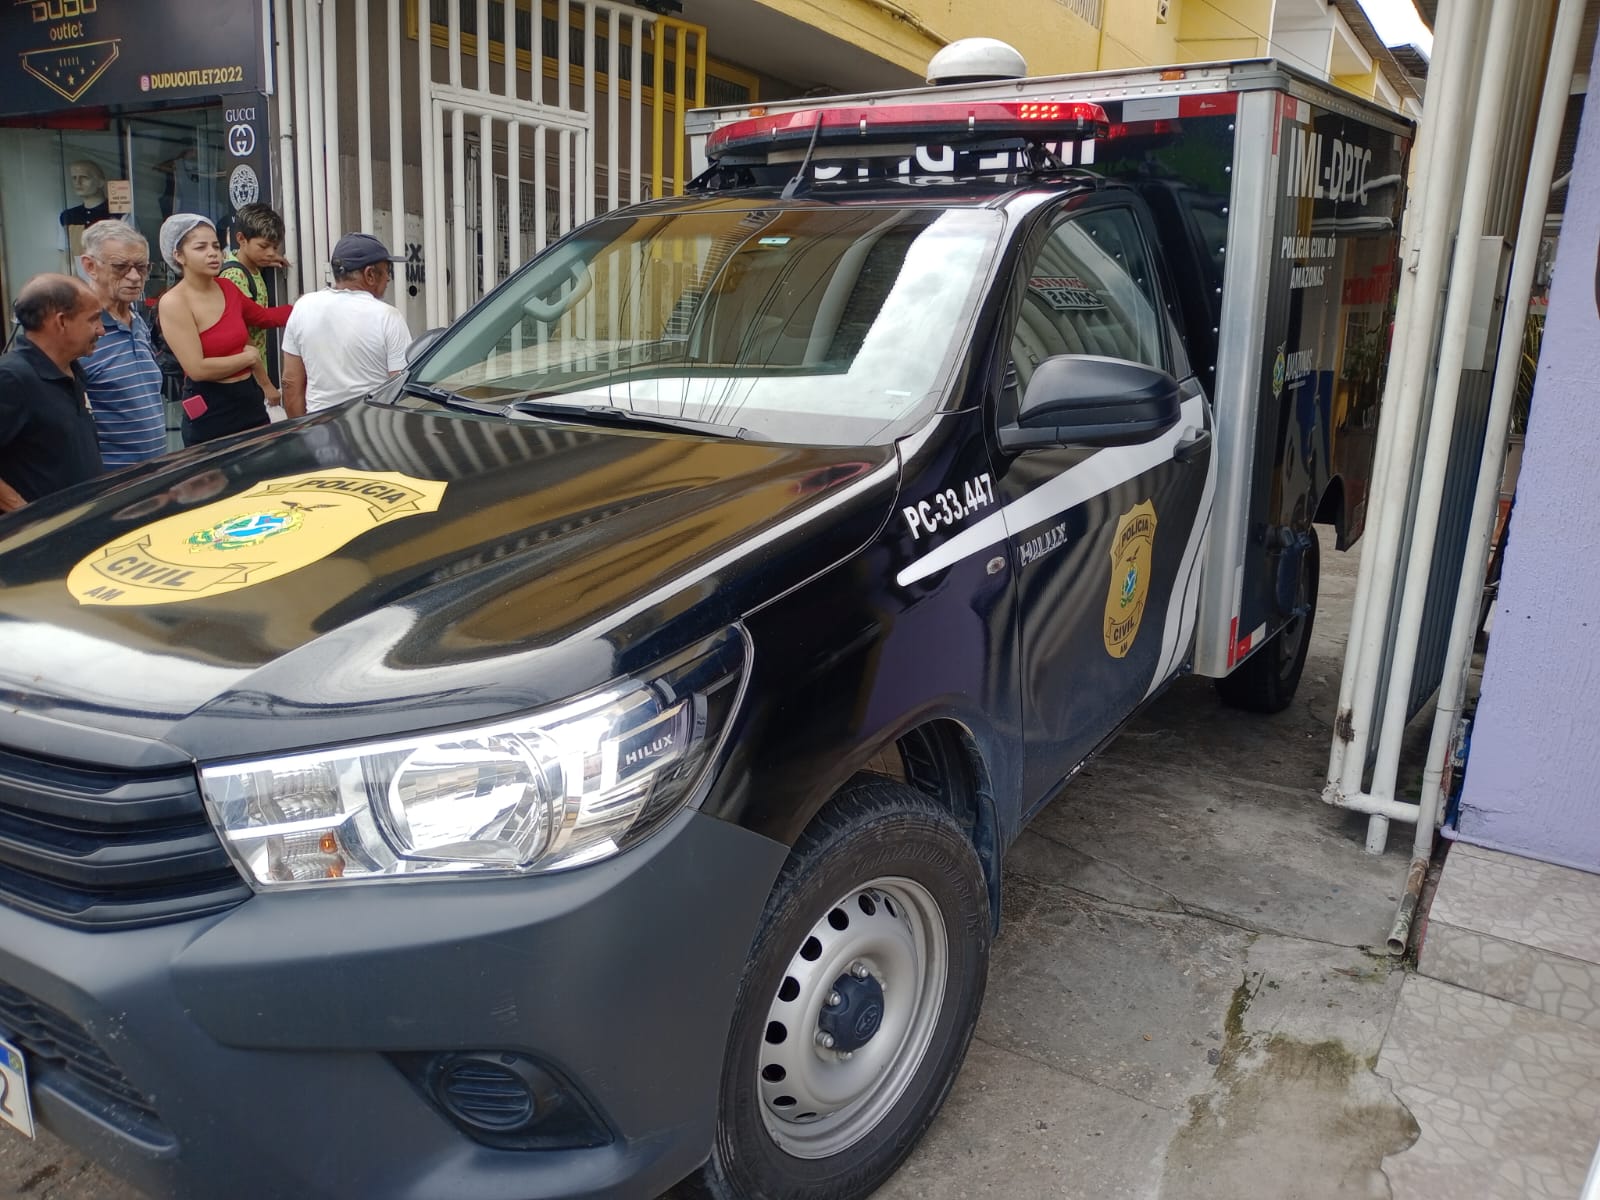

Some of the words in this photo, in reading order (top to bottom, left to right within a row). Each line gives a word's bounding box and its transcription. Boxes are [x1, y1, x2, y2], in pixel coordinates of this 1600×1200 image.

[49, 20, 84, 41] outlet
[151, 66, 243, 89] DUDUOUTLET2022
[225, 107, 256, 122] GUCCI
[1287, 127, 1372, 206] IML-DPTC
[1290, 266, 1325, 289] AMAZONAS
[295, 477, 406, 505] POLÍCIA
[902, 472, 995, 540] PC-33.447
[1121, 518, 1149, 548] POLÍCIA
[106, 555, 195, 589] CIVIL
[84, 585, 127, 602] AM
[1113, 619, 1135, 641] CIVIL
[1119, 642, 1128, 654] AM
[625, 733, 674, 766] HILUX
